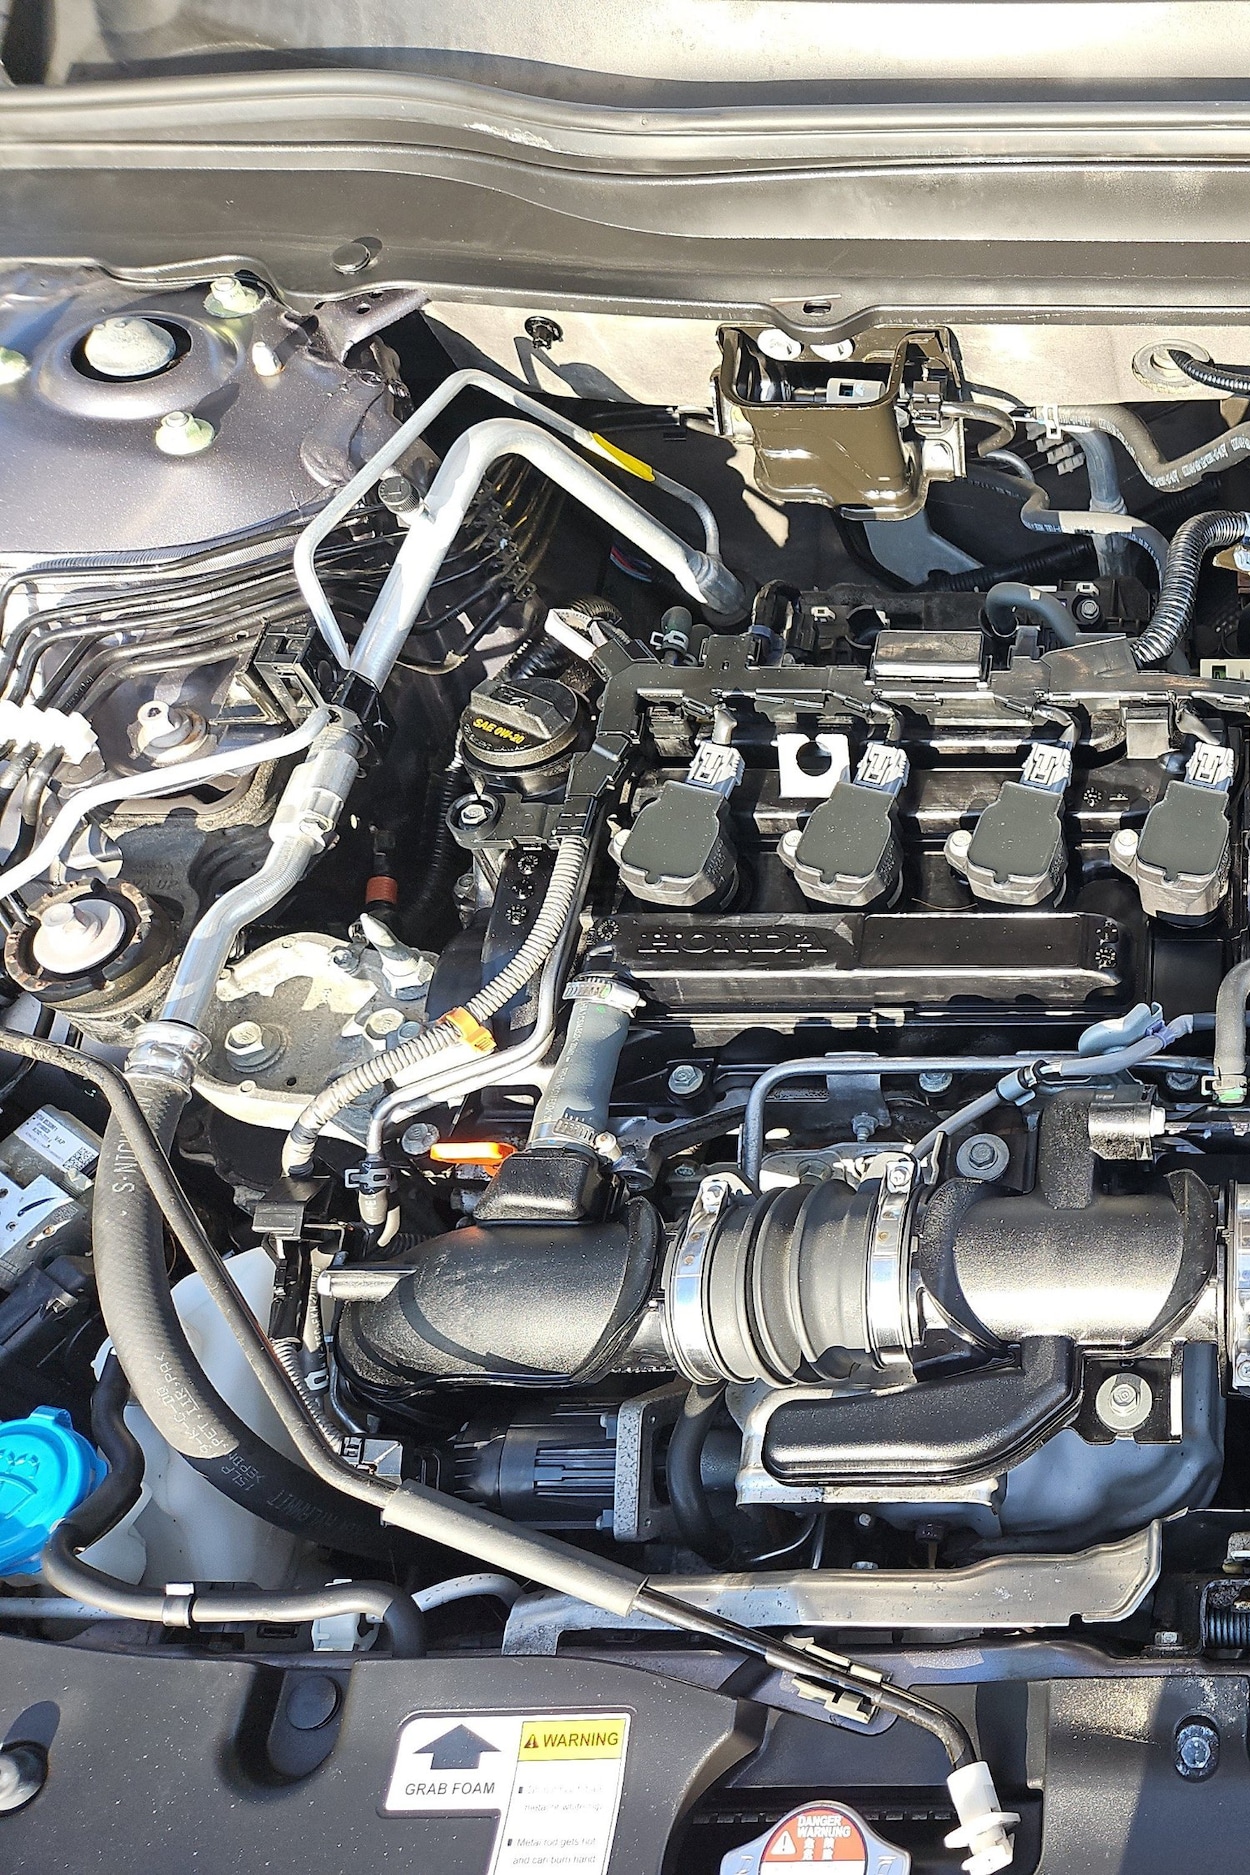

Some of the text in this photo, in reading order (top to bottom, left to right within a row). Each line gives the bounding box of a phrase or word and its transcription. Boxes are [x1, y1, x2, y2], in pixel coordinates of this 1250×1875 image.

[473, 718, 525, 744] SAE 0W-20
[637, 931, 828, 954] HONDA
[542, 1732, 619, 1749] WARNING
[405, 1782, 495, 1796] GRAB FOAM
[797, 1815, 843, 1827] DANGER
[797, 1826, 851, 1838] WARNUNG
[561, 1839, 579, 1848] gets
